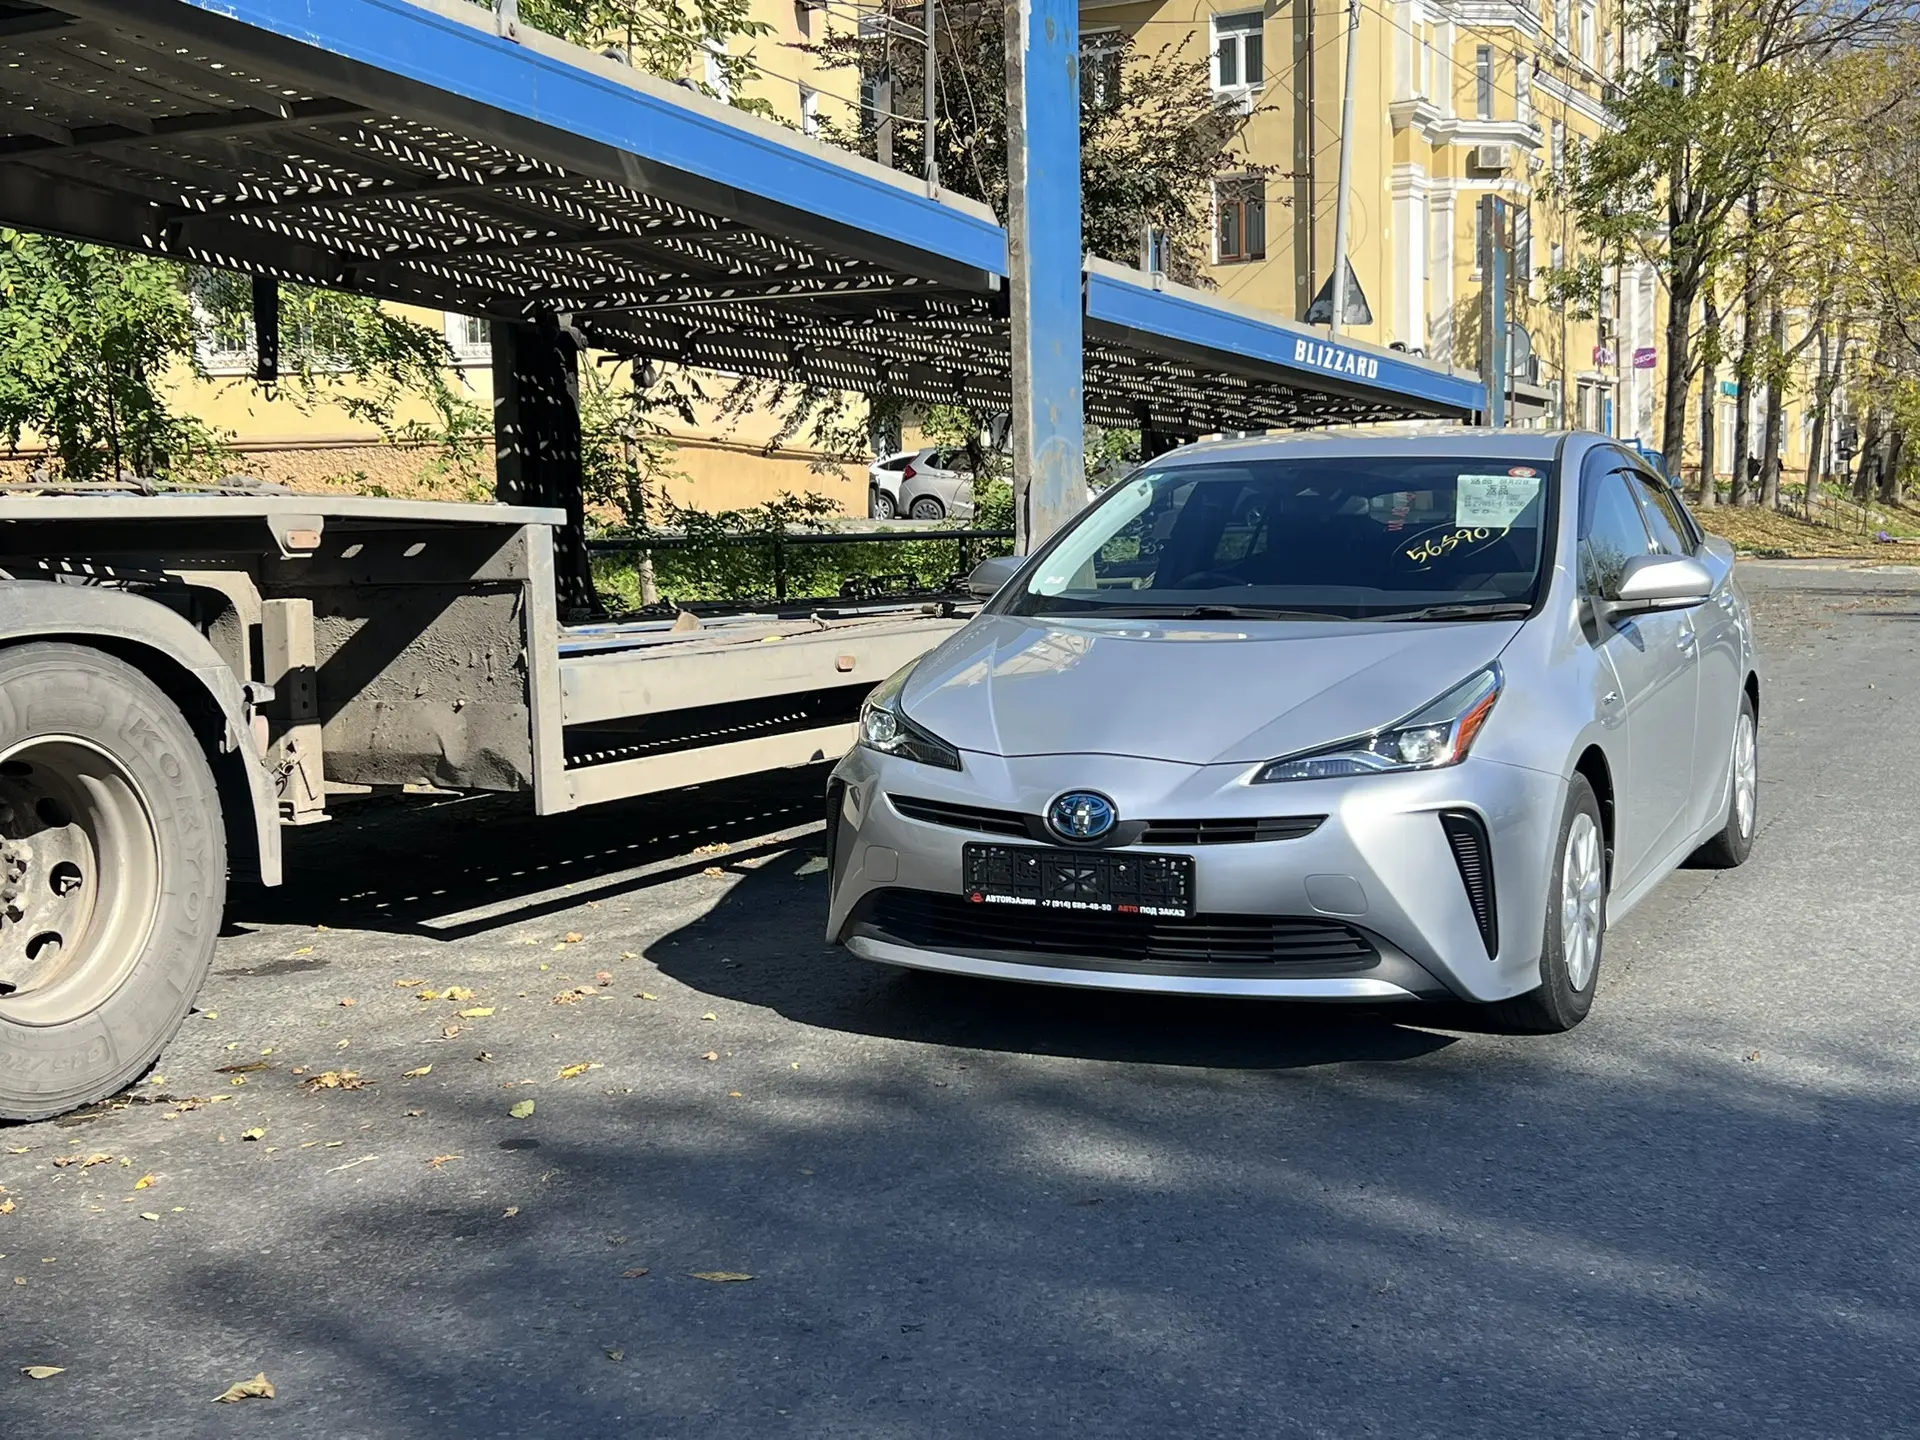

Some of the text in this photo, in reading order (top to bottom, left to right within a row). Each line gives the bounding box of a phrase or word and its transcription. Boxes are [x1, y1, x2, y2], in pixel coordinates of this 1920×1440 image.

[1294, 339, 1378, 379] BLIZZARD
[1406, 527, 1490, 563] 56590
[1042, 899, 1051, 907] +7
[1118, 904, 1138, 913] АВТО
[1140, 905, 1157, 915] ПОД
[1158, 907, 1186, 917] ЗАКАЗ
